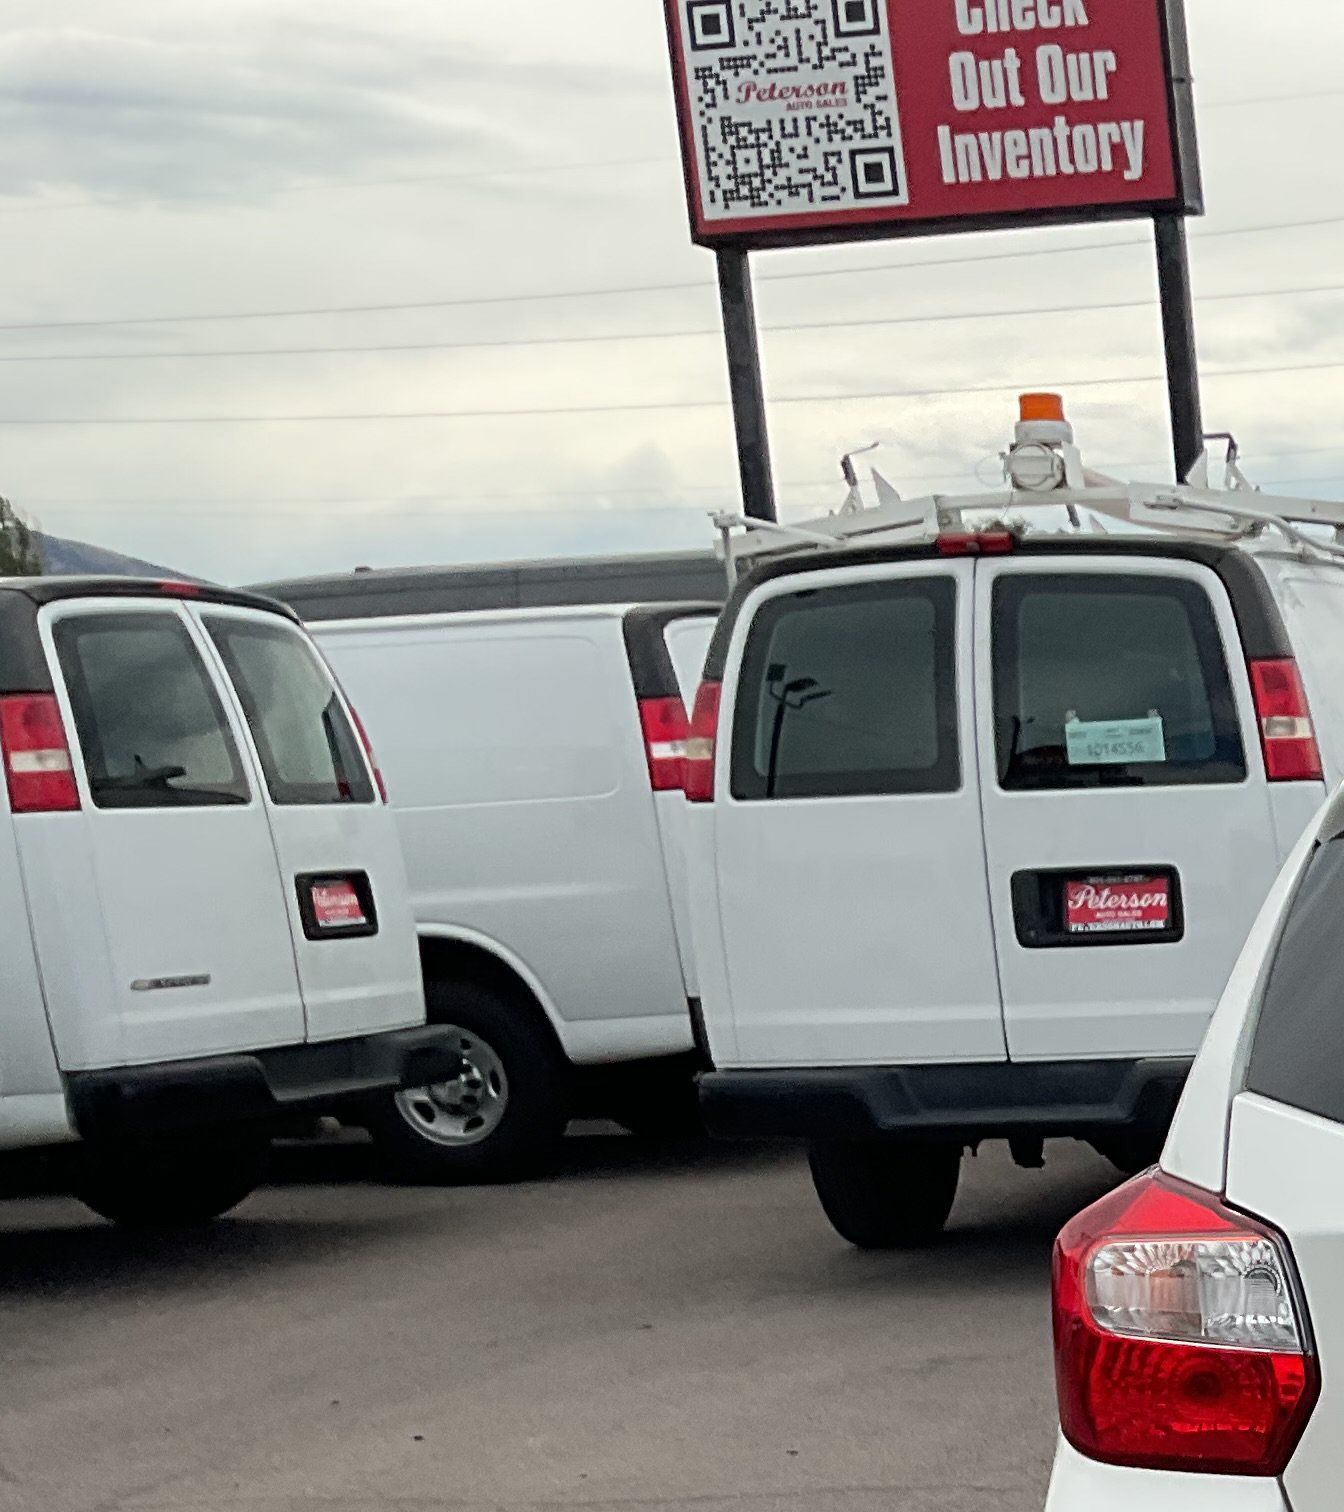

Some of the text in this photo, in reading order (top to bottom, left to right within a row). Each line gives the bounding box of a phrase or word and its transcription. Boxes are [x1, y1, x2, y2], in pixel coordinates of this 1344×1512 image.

[949, 44, 1117, 111] Out Our
[736, 81, 847, 103] Peterson
[786, 98, 848, 111] AUTO SALES
[937, 116, 1144, 183] Inventory
[1068, 884, 1168, 909] Peterson
